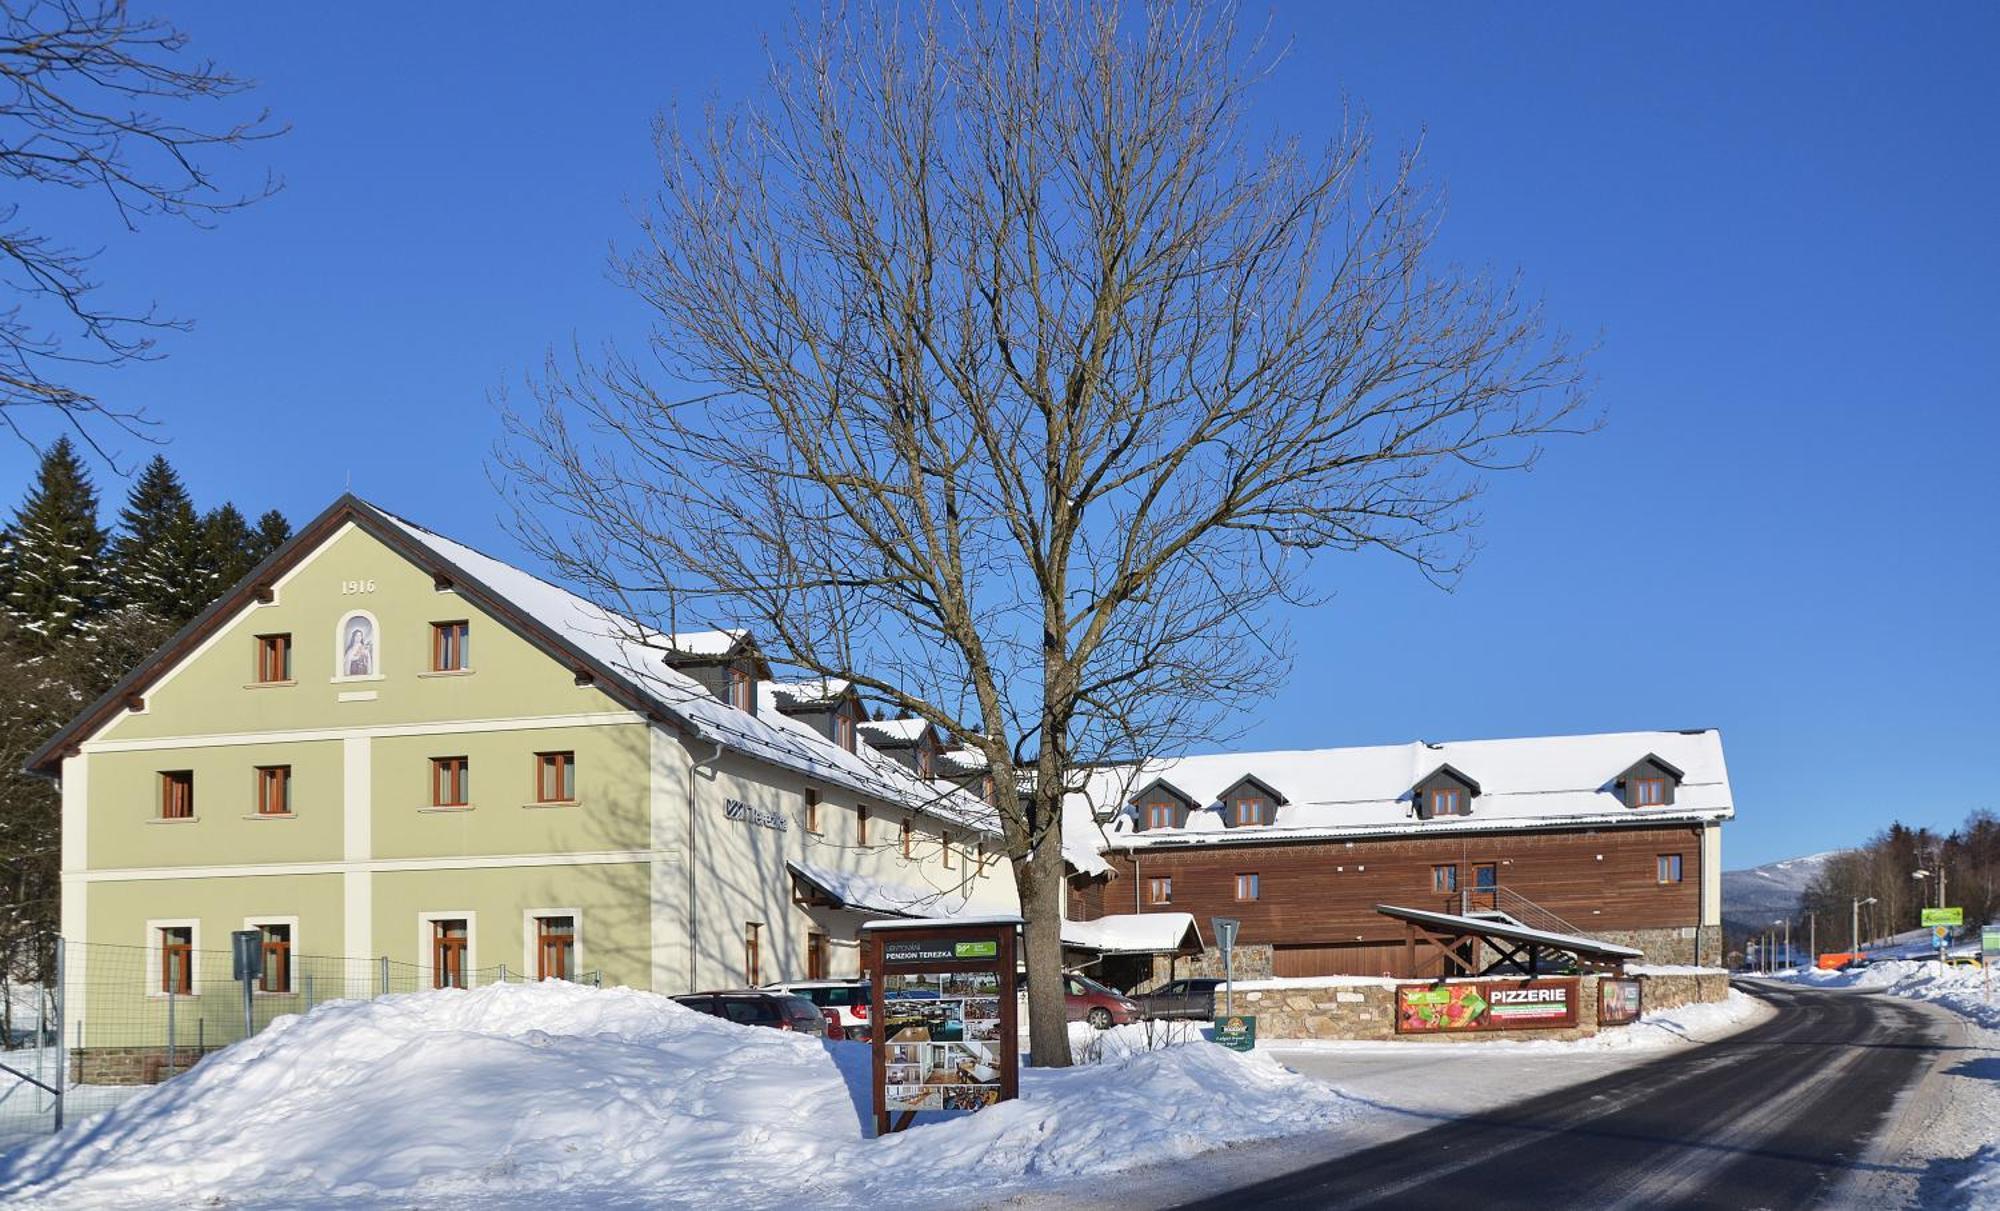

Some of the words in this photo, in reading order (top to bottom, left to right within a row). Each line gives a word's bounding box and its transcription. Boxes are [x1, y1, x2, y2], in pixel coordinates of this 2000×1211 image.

[342, 580, 376, 594] 1916
[885, 951, 918, 960] PENZION
[919, 950, 953, 958] TEREZKA
[1490, 988, 1567, 1004] PIZZERIE
